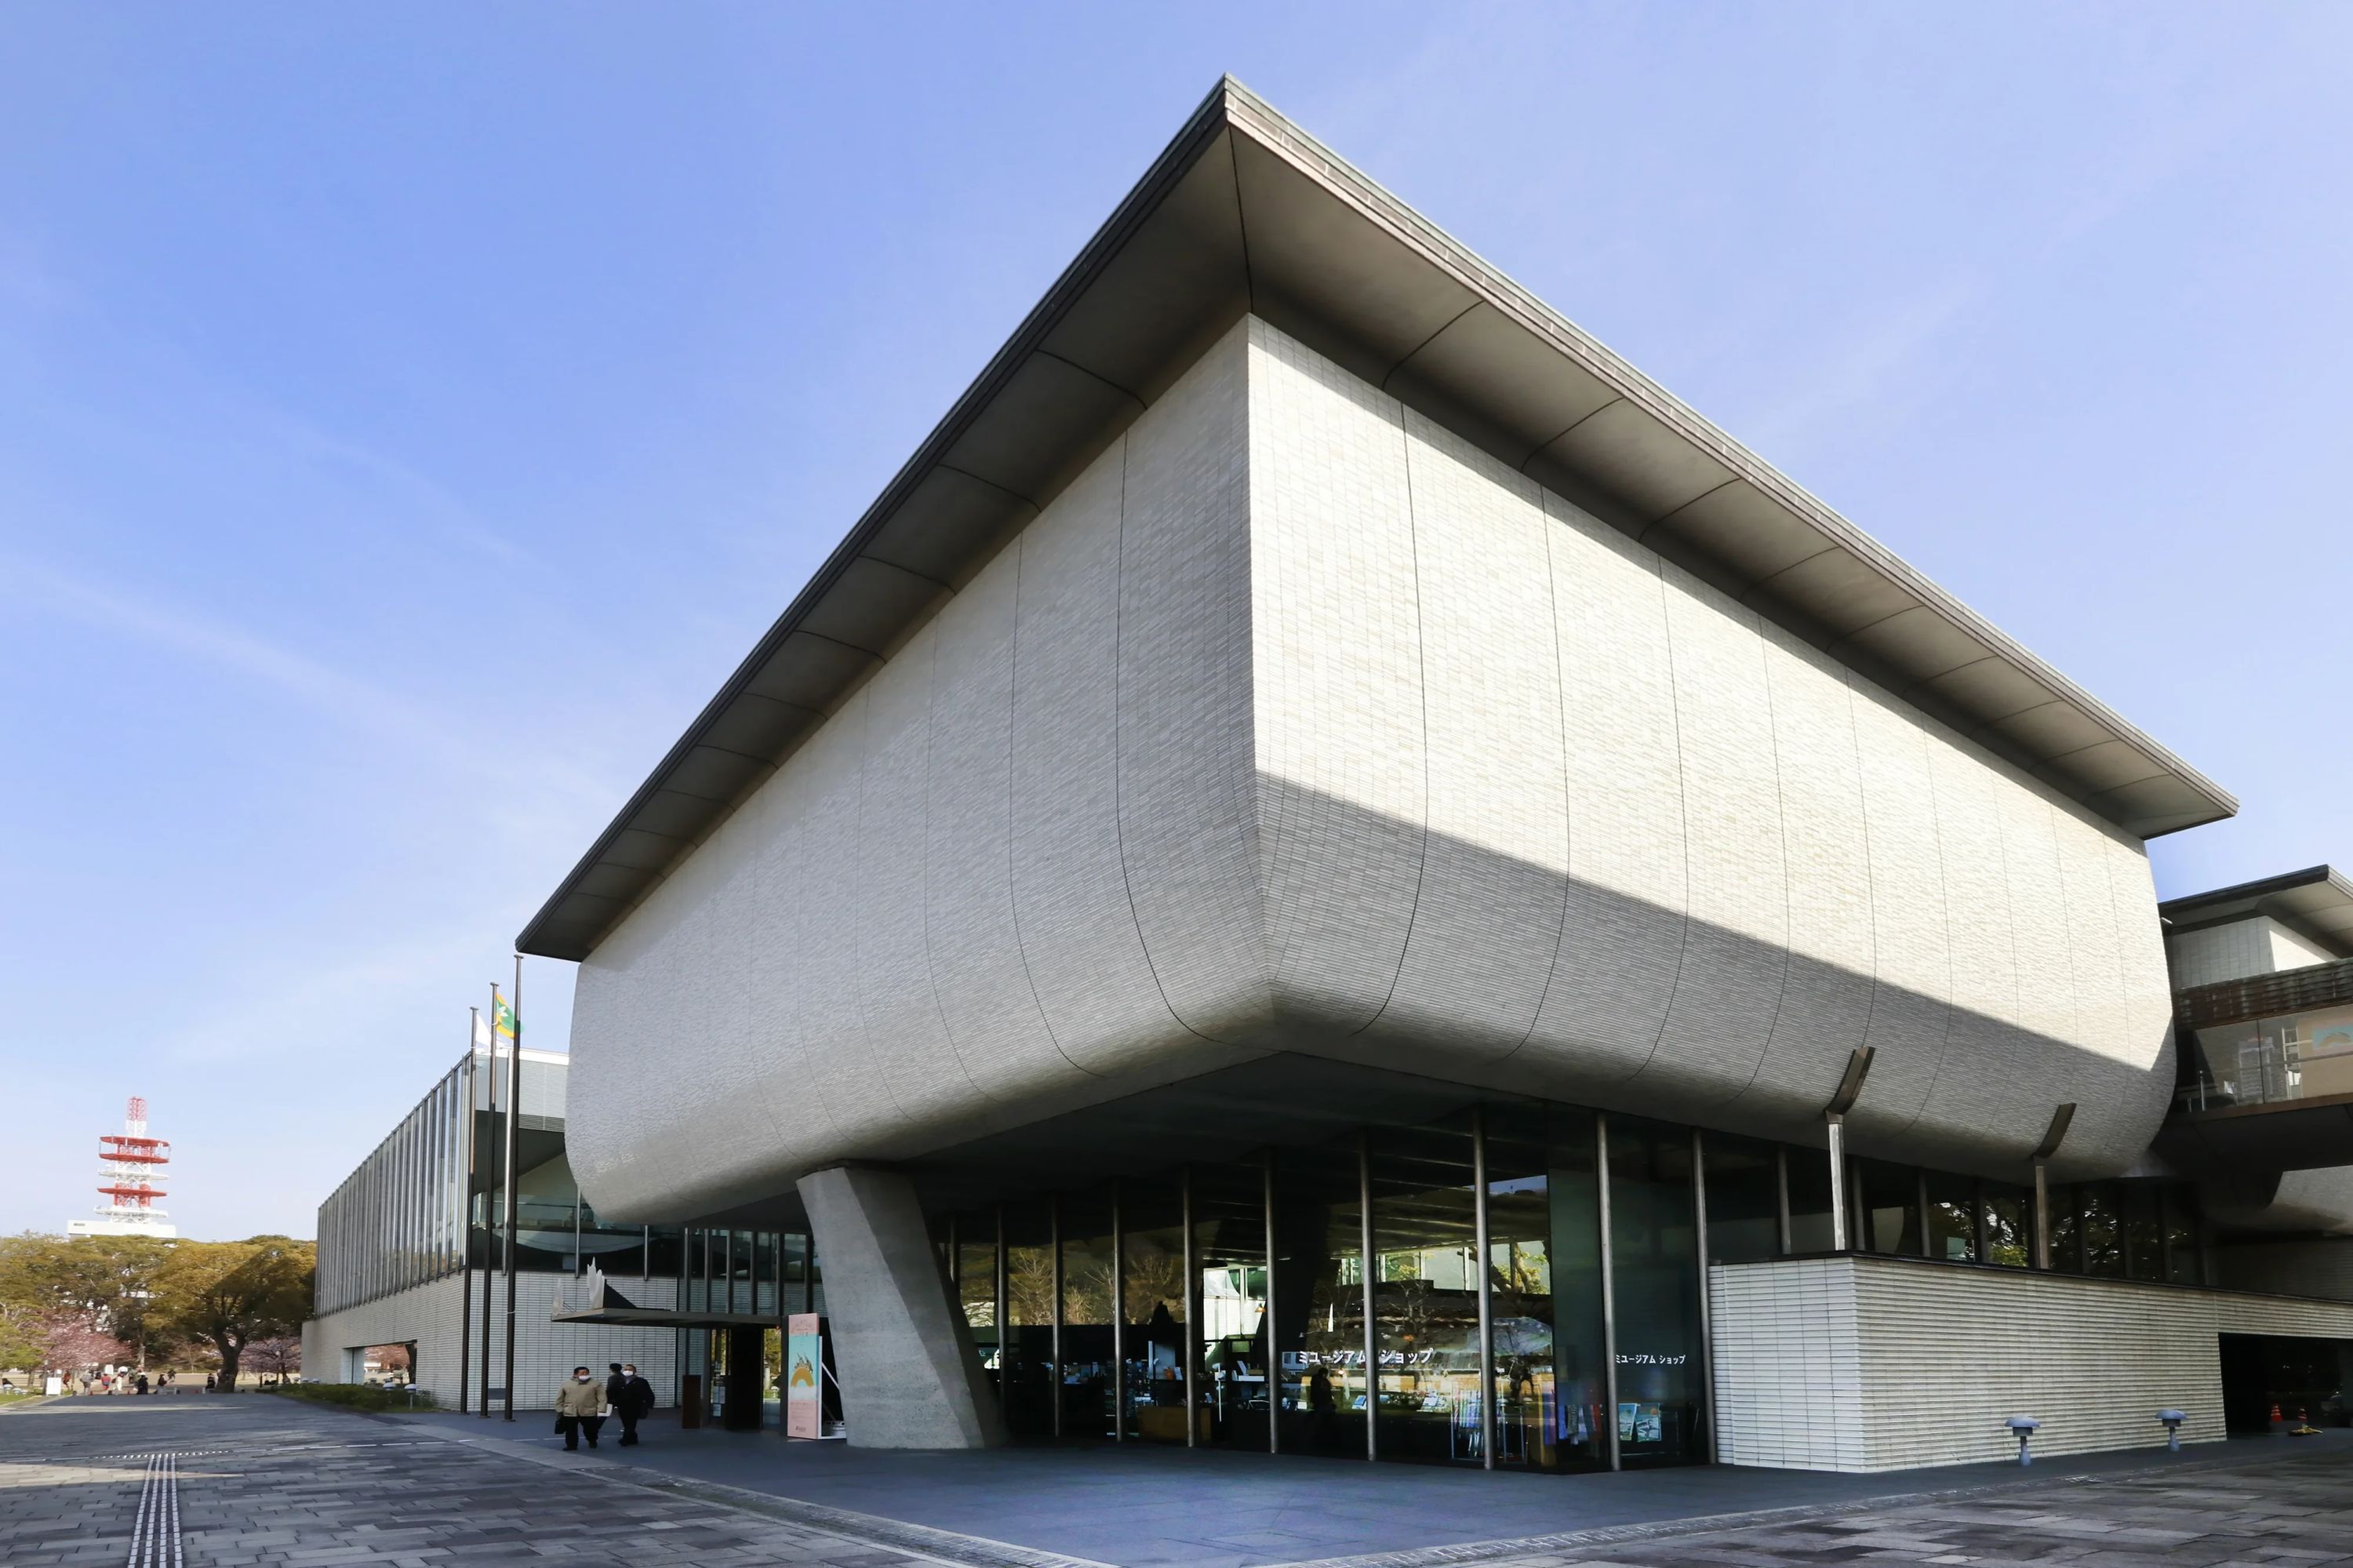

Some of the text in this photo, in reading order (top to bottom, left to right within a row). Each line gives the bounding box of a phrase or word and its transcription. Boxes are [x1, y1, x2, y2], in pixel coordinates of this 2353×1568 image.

[1380, 1348, 1434, 1364] ショップ
[1616, 1354, 1686, 1365] ミュージアム ショップ
